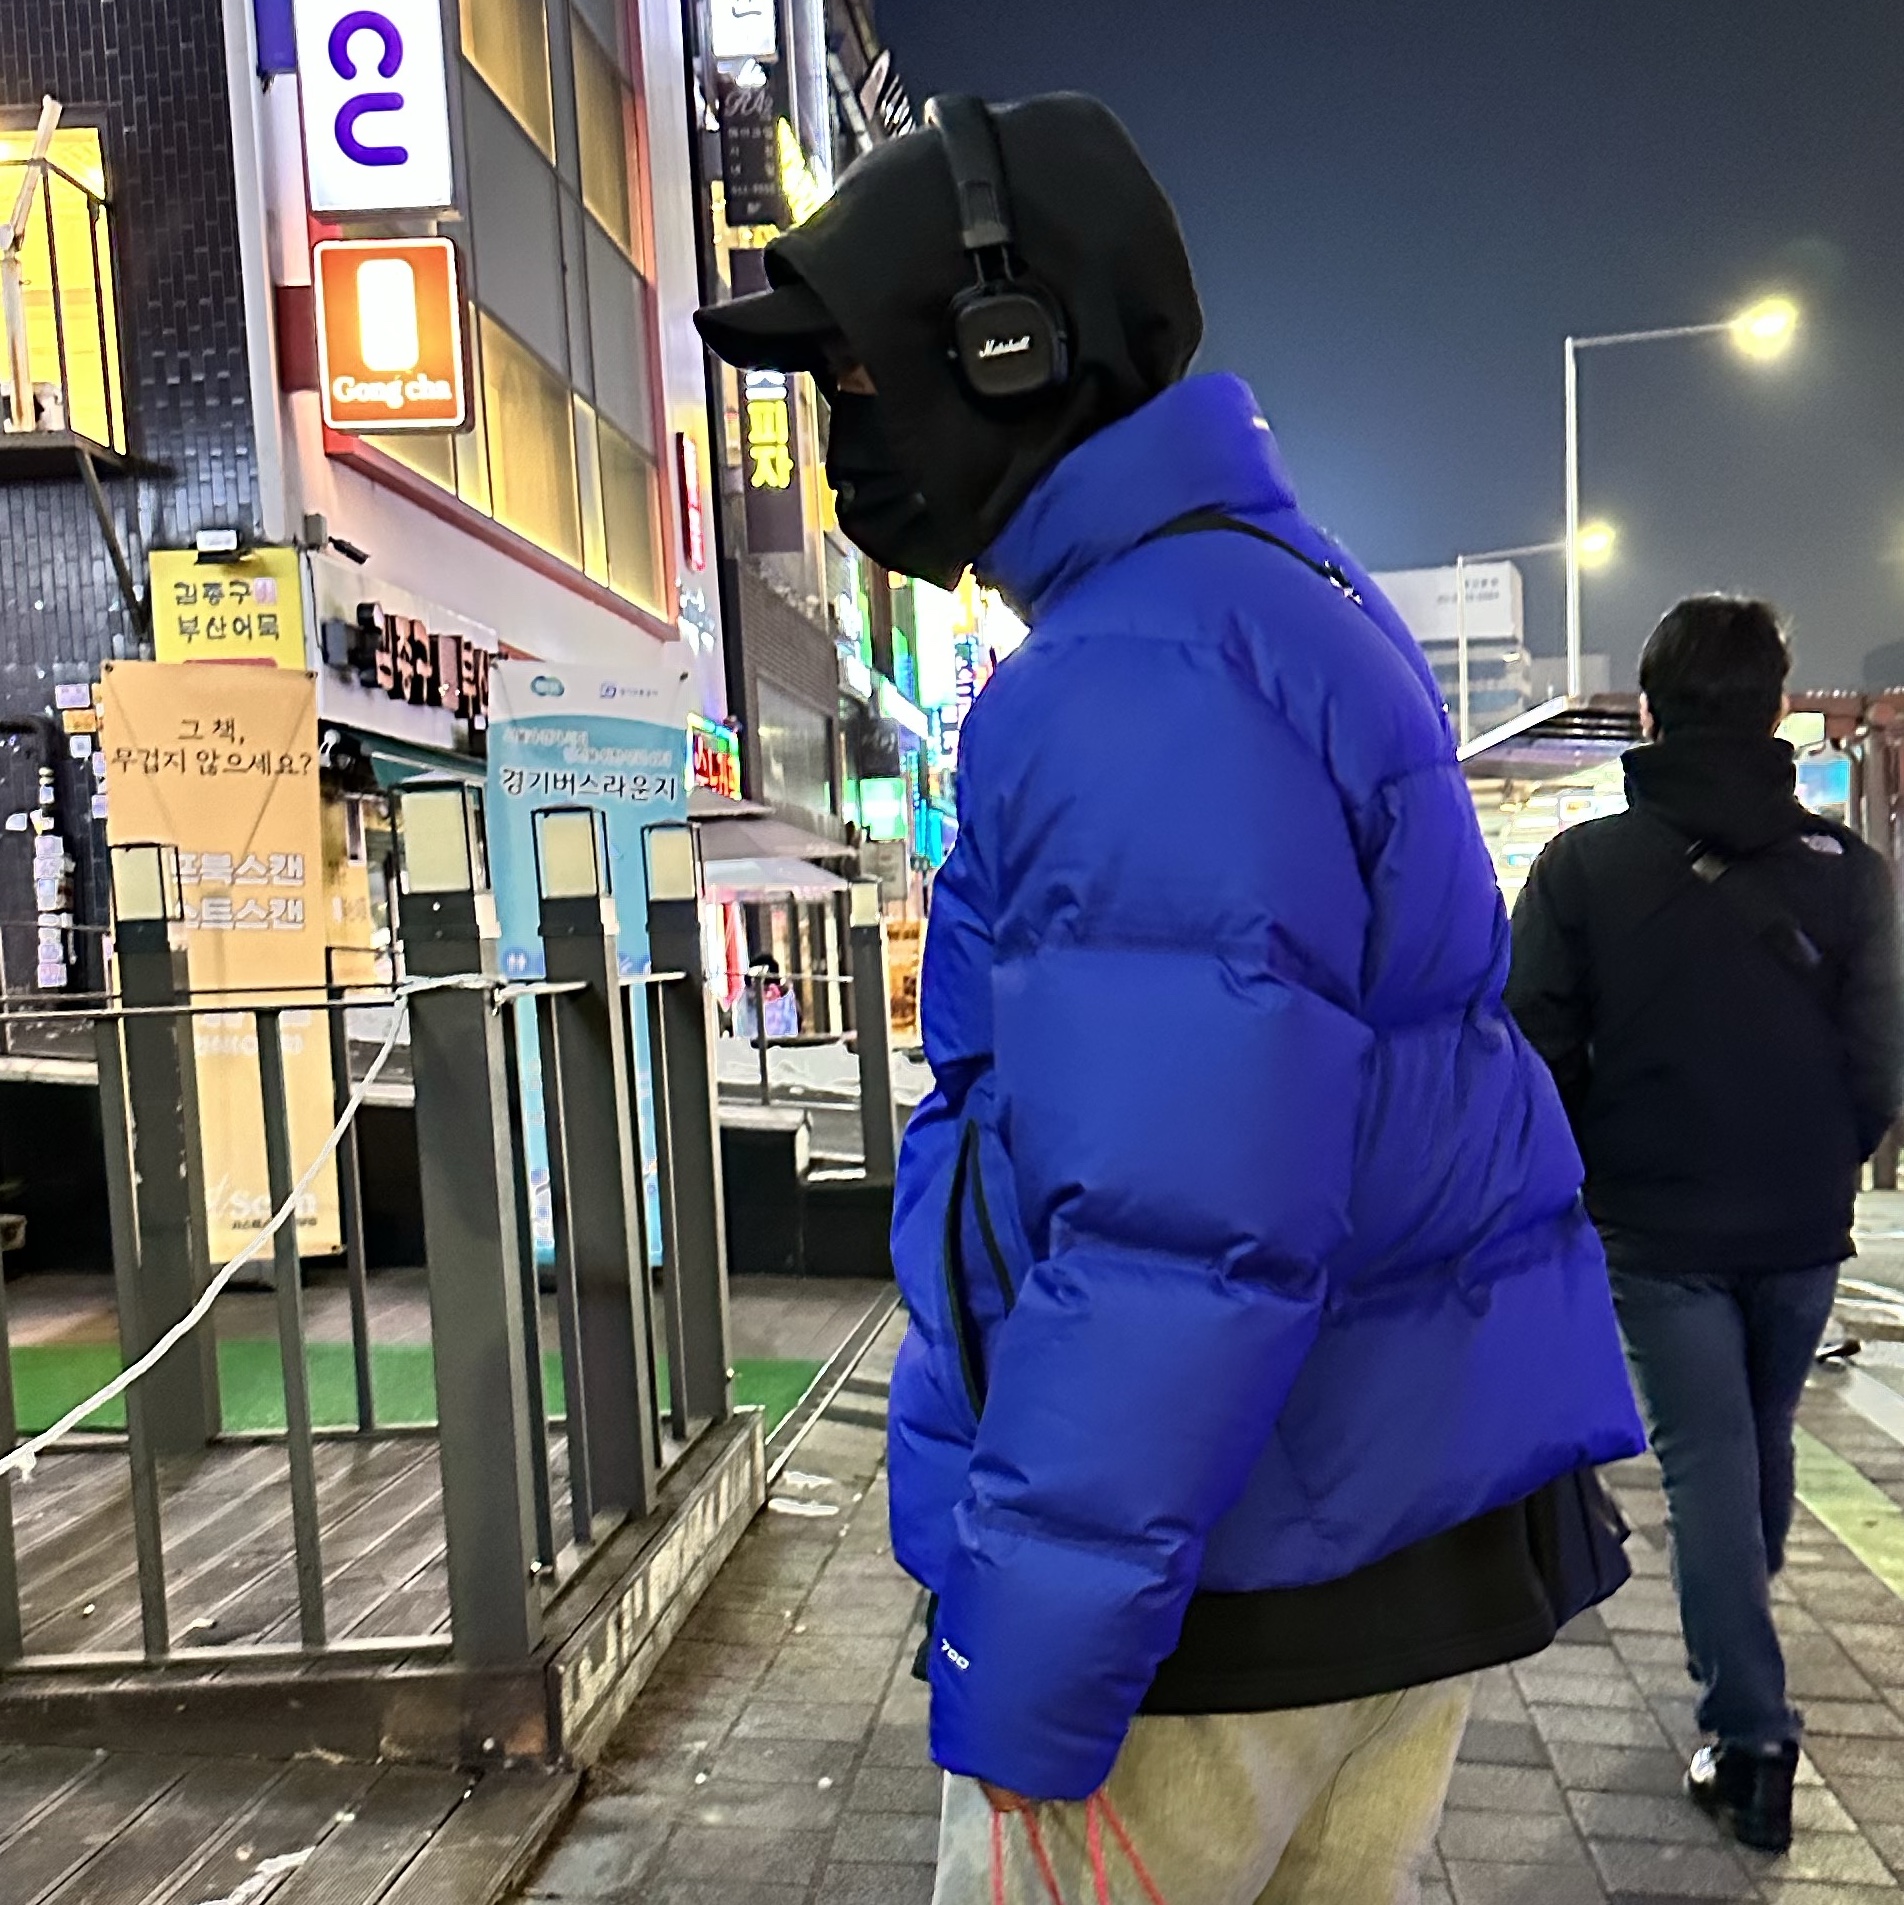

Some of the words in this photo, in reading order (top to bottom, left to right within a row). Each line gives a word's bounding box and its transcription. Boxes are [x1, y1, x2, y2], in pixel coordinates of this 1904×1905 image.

[328, 10, 409, 167] CU
[173, 581, 251, 606] 김종구
[178, 613, 280, 643] 부산어묵
[178, 718, 204, 740] 그
[213, 716, 245, 745] 책,
[111, 747, 186, 776] 무겁지
[196, 748, 312, 777] 않으세요?
[502, 767, 676, 802] 경기버스라운지
[941, 1637, 970, 1670] 700
